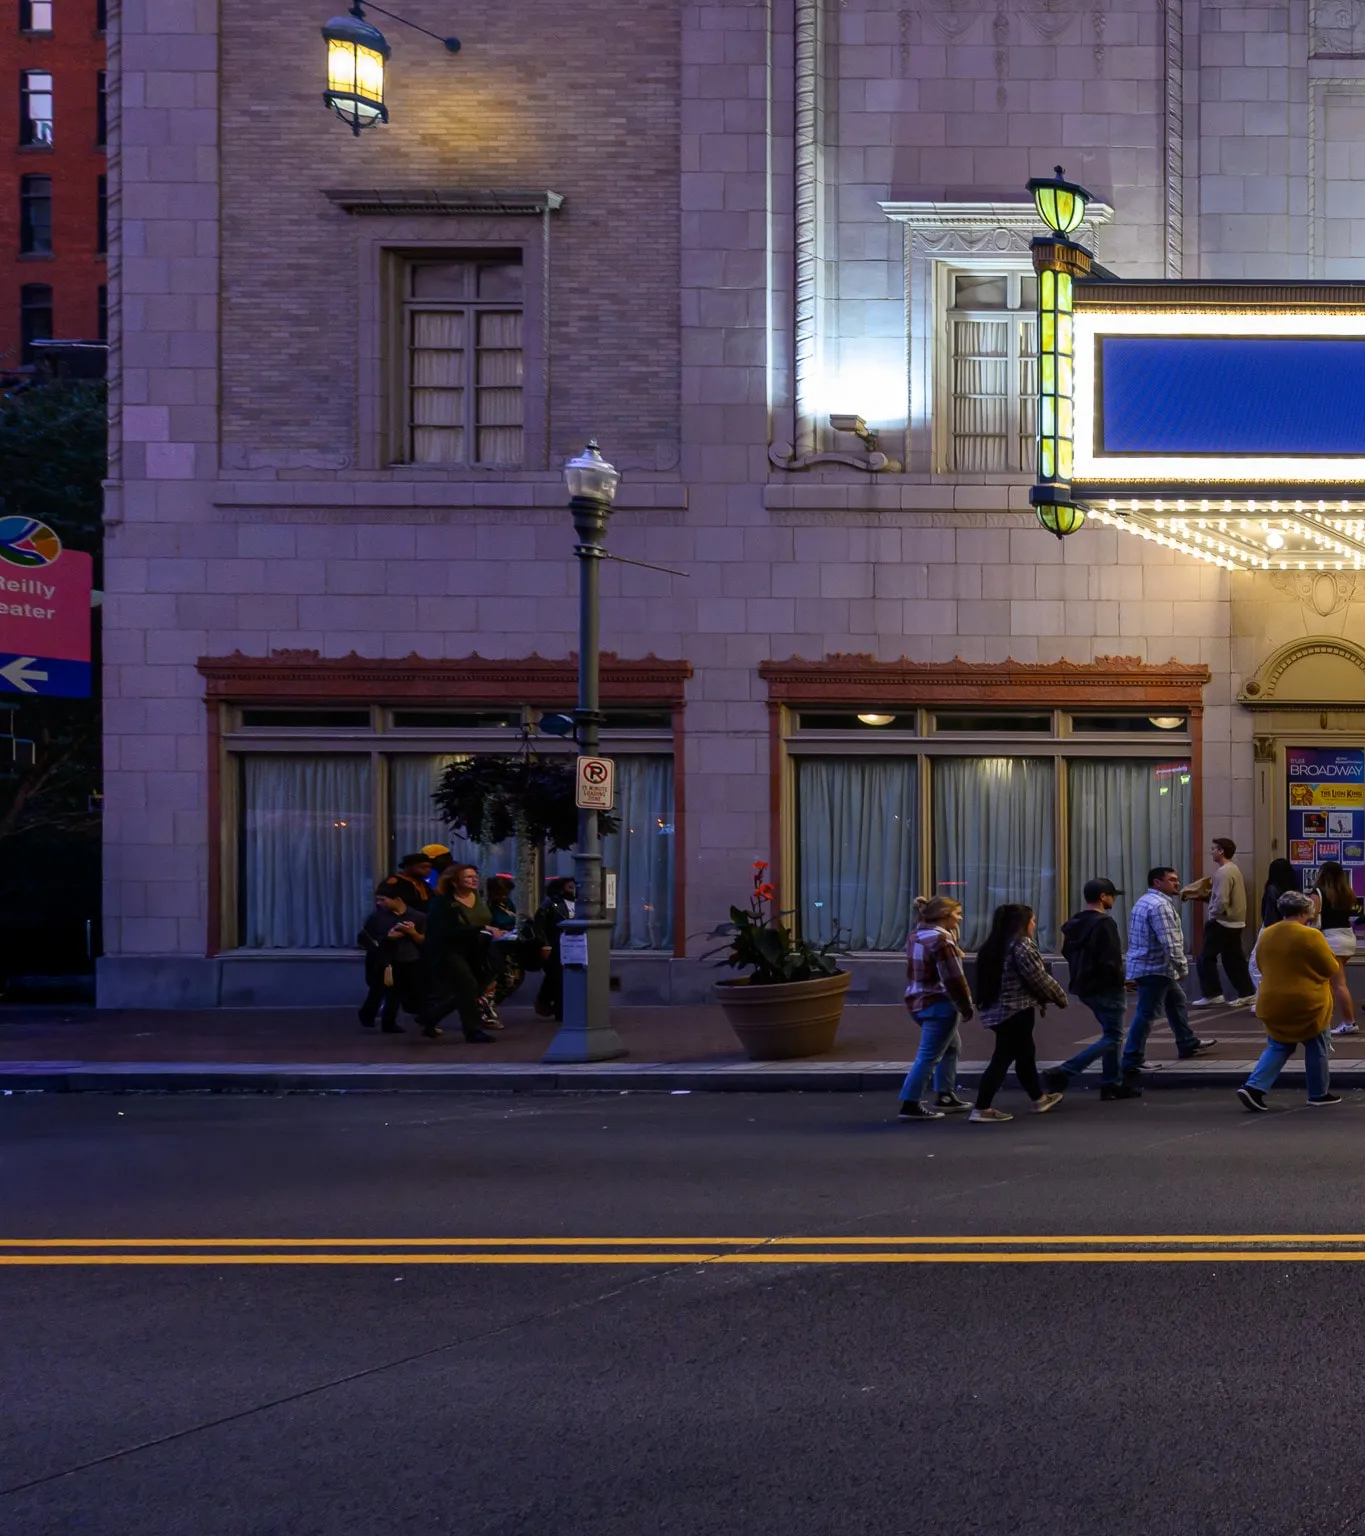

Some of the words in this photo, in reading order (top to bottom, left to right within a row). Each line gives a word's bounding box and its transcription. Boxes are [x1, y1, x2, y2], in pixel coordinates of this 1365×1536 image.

[1290, 765, 1363, 776] BROADWAY
[1332, 789, 1346, 799] LION
[1346, 789, 1363, 799] KING
